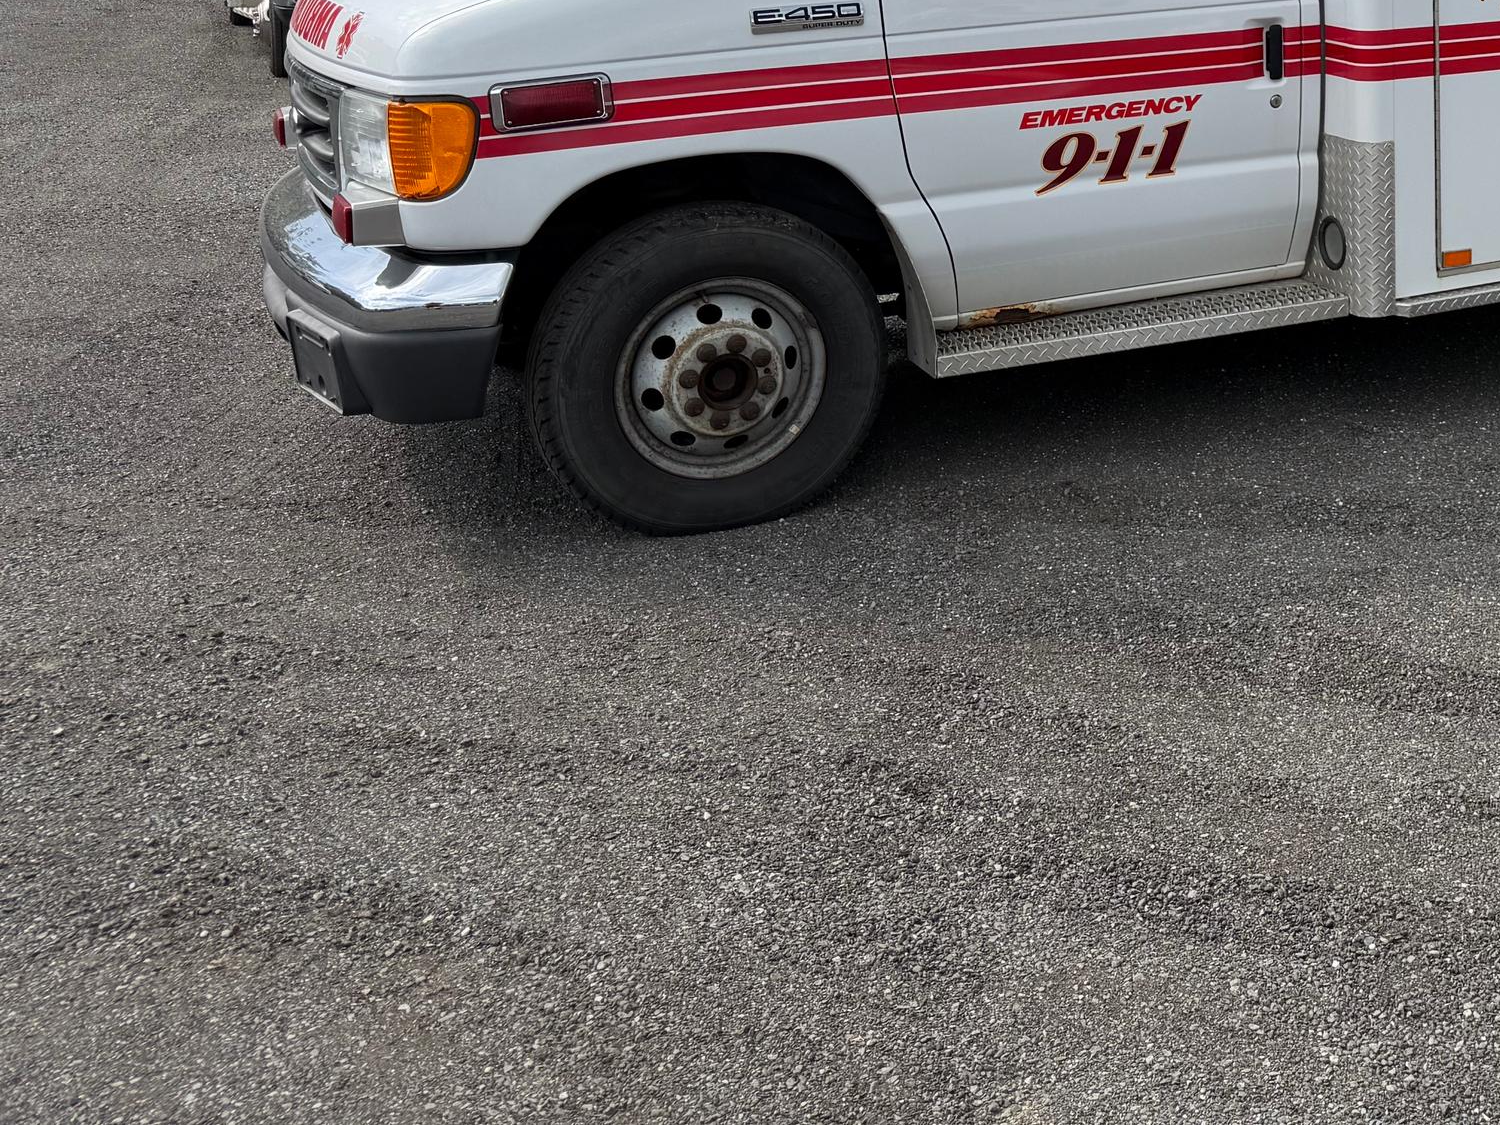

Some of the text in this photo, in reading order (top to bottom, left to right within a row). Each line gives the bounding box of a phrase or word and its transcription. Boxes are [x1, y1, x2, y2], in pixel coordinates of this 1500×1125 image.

[752, 2, 862, 25] E-450
[835, 19, 861, 27] DUTY
[1019, 94, 1203, 130] EMERGENCY
